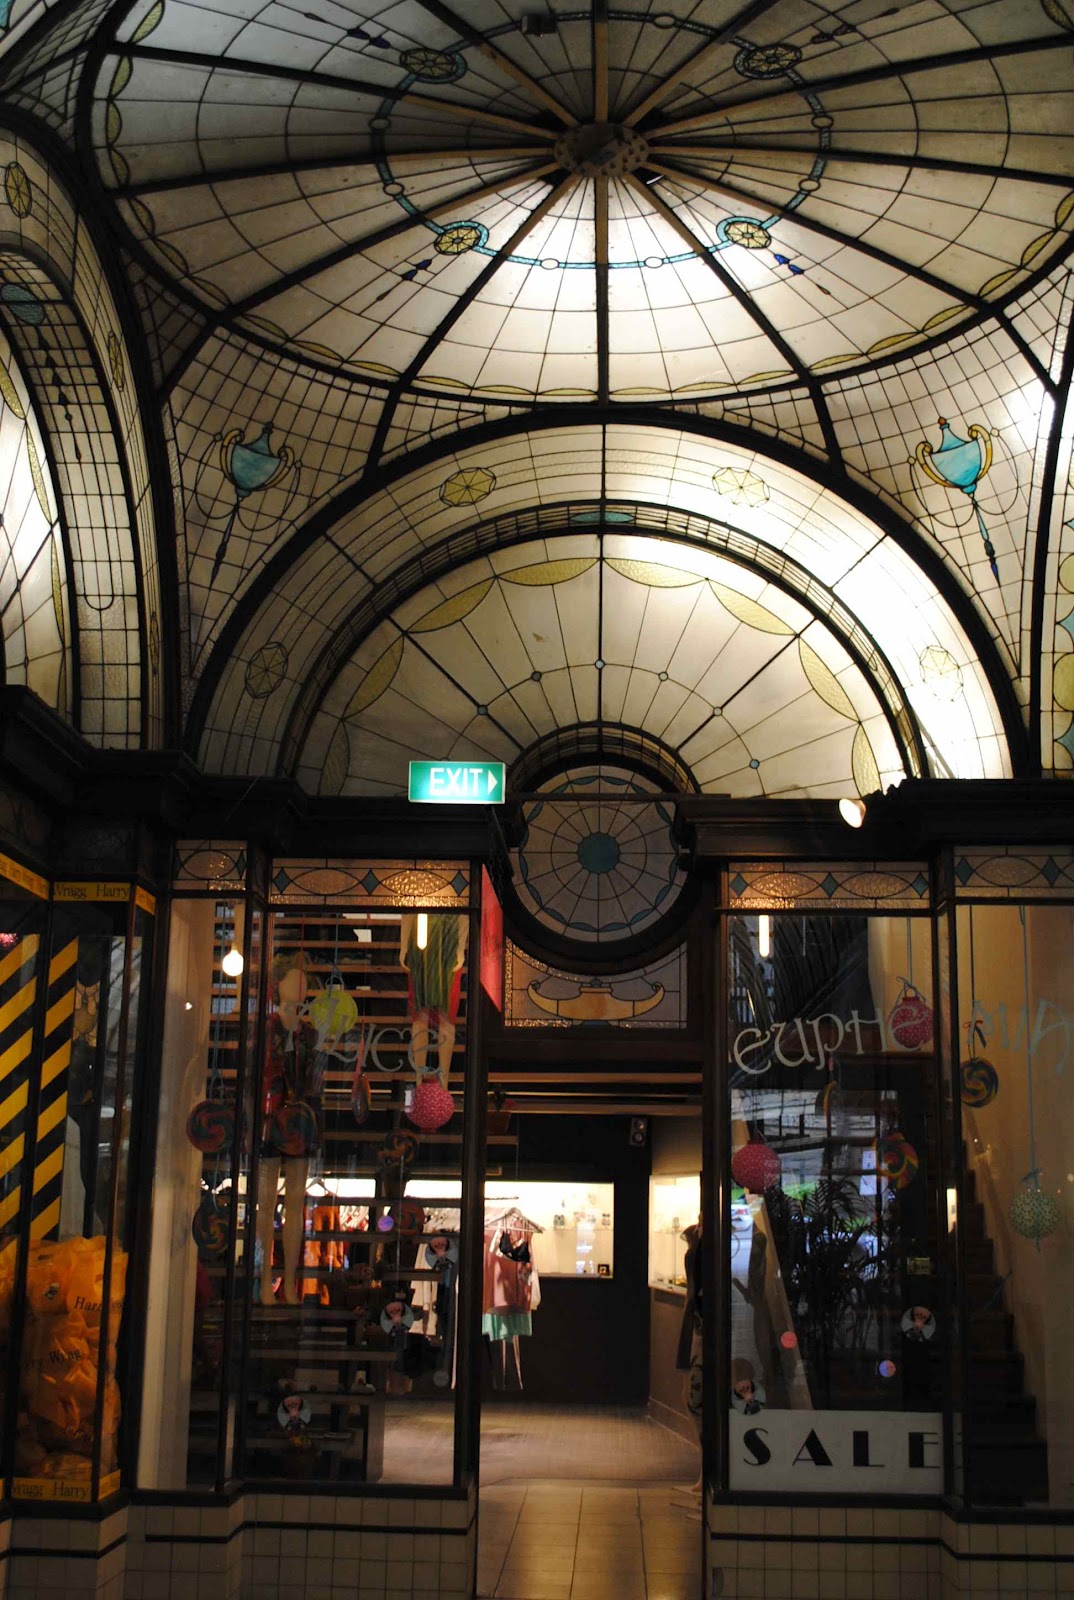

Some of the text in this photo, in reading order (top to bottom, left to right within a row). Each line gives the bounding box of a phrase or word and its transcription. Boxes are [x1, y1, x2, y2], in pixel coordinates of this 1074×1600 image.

[429, 767, 484, 797] EXIT
[96, 883, 129, 900] Harry
[284, 998, 447, 1075] ALICE
[743, 1427, 941, 1469] SALE
[53, 1481, 91, 1500] Harry
